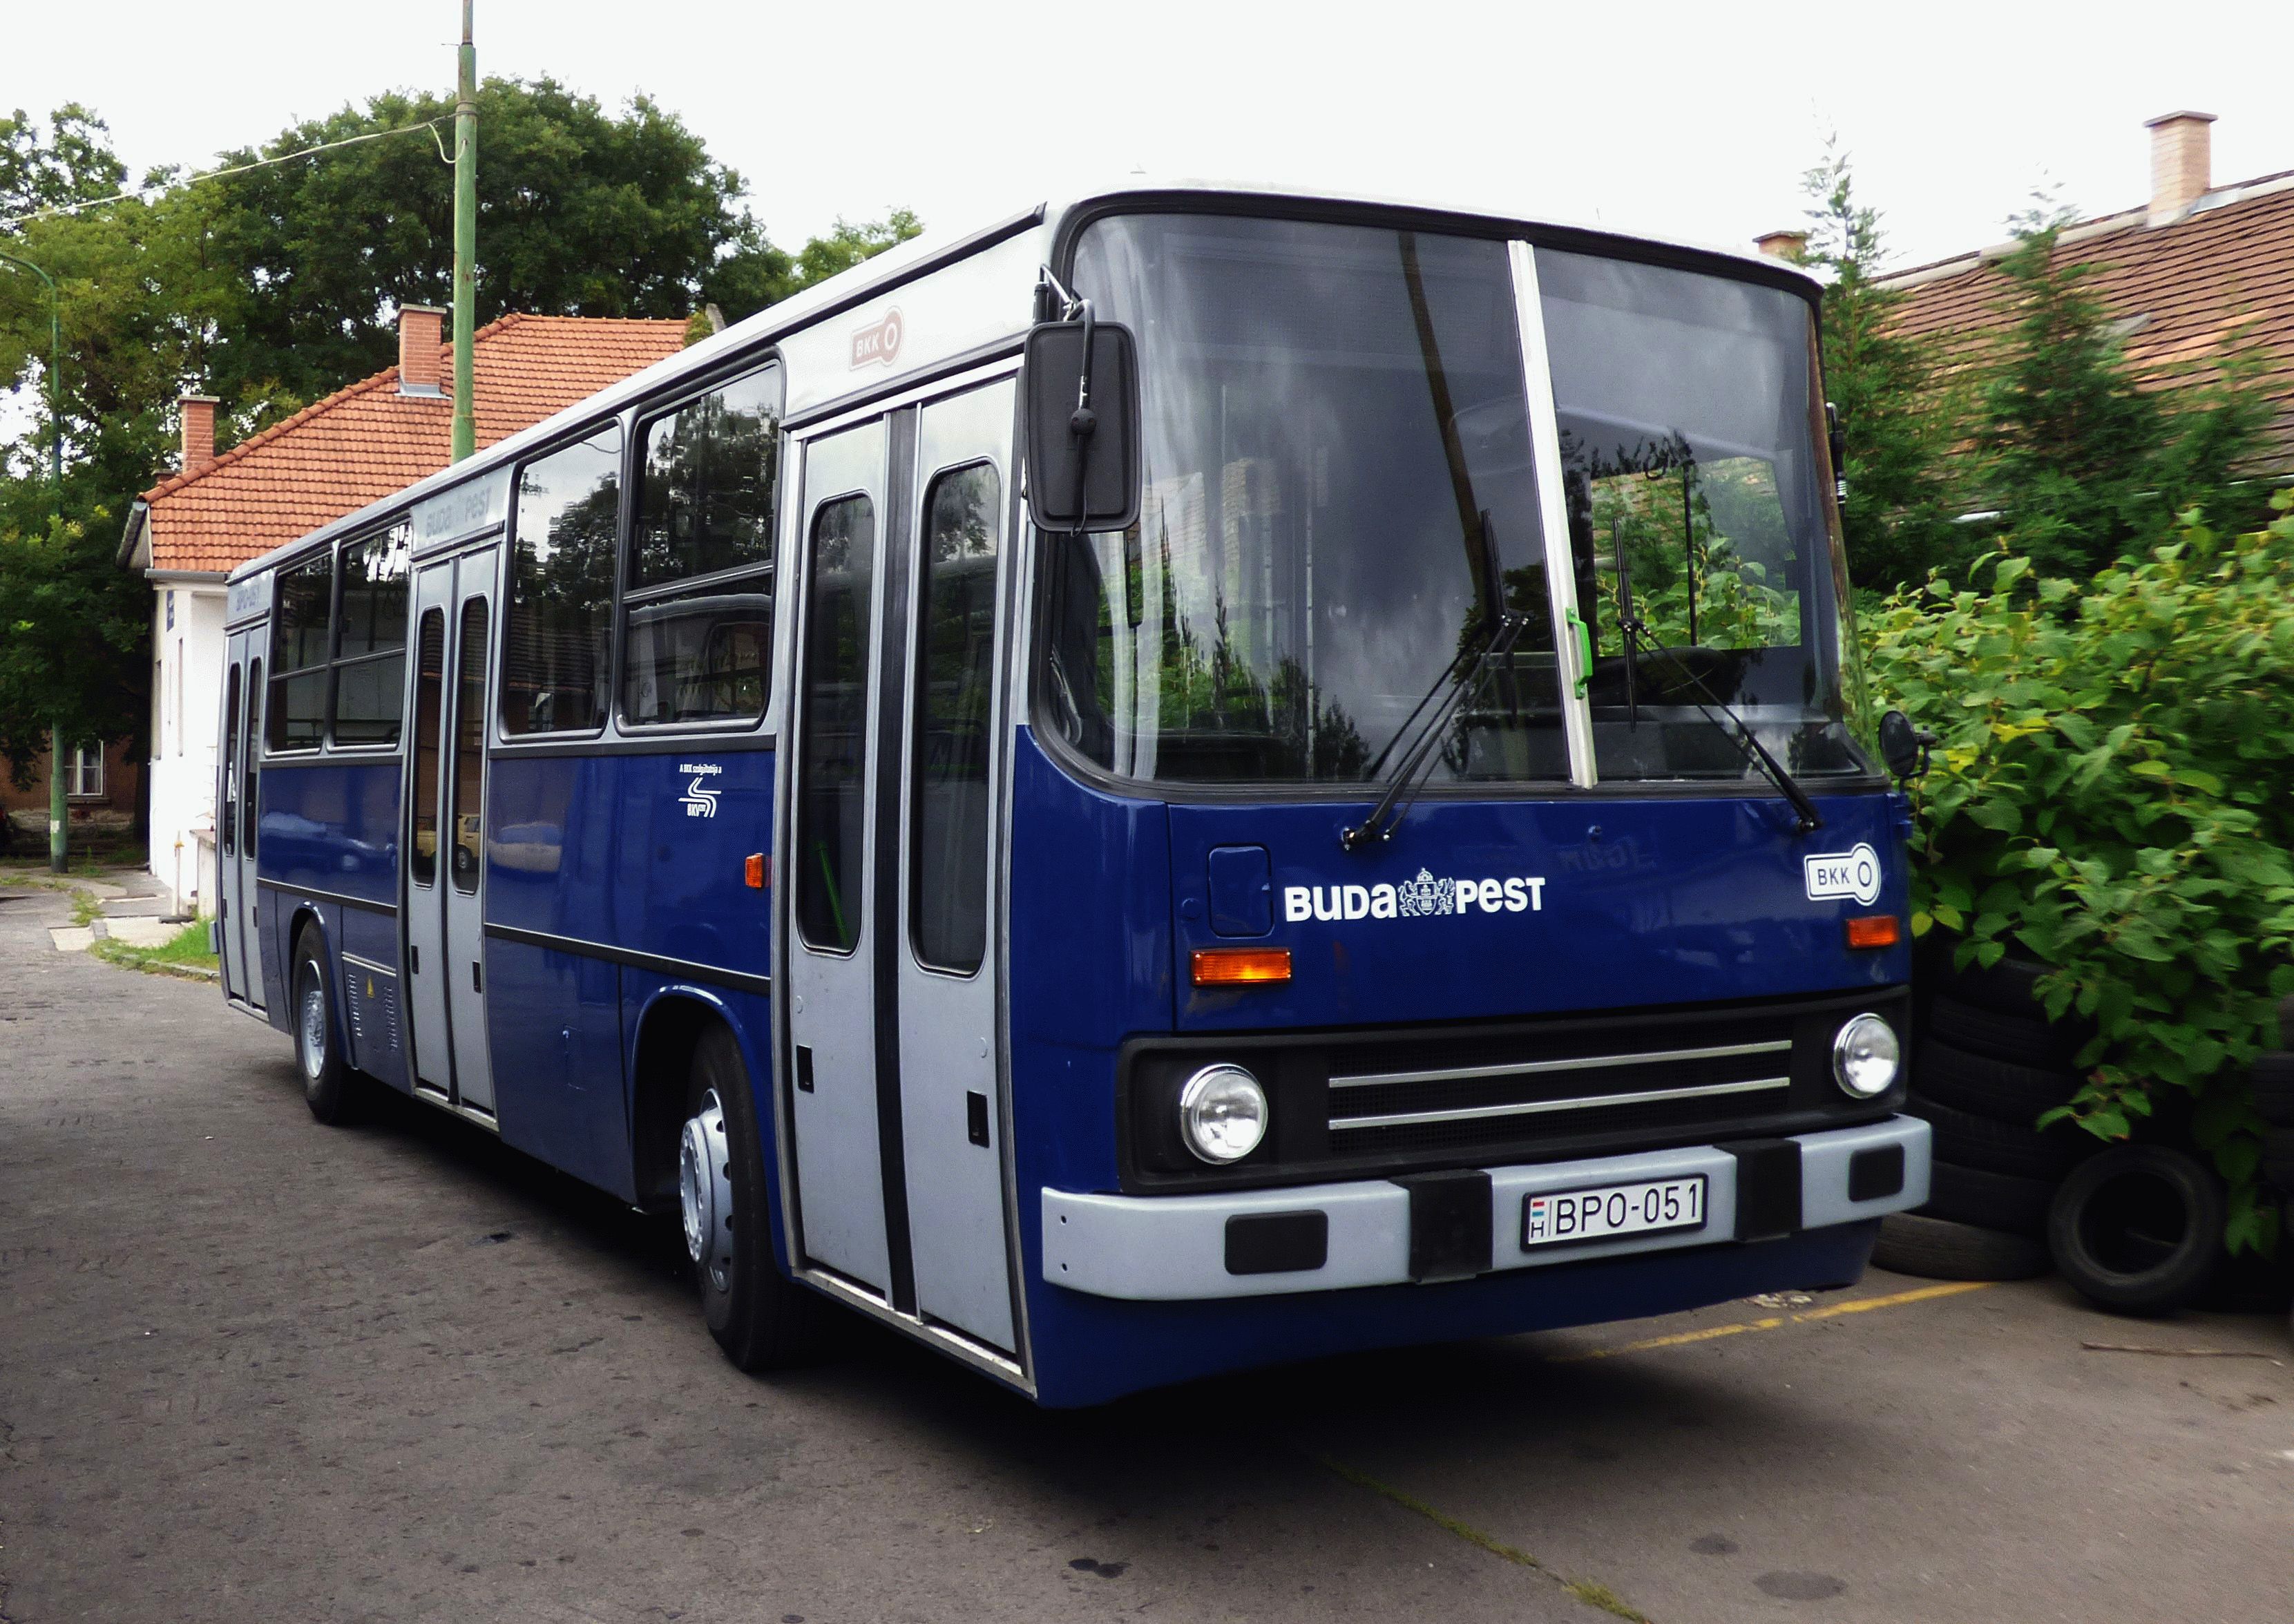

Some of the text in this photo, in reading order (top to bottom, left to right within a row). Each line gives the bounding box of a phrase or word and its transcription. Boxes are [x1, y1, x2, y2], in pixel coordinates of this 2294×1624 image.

[856, 332, 880, 358] BKK
[1817, 867, 1851, 886] BKK
[1531, 1183, 1697, 1239] H BPO-051
